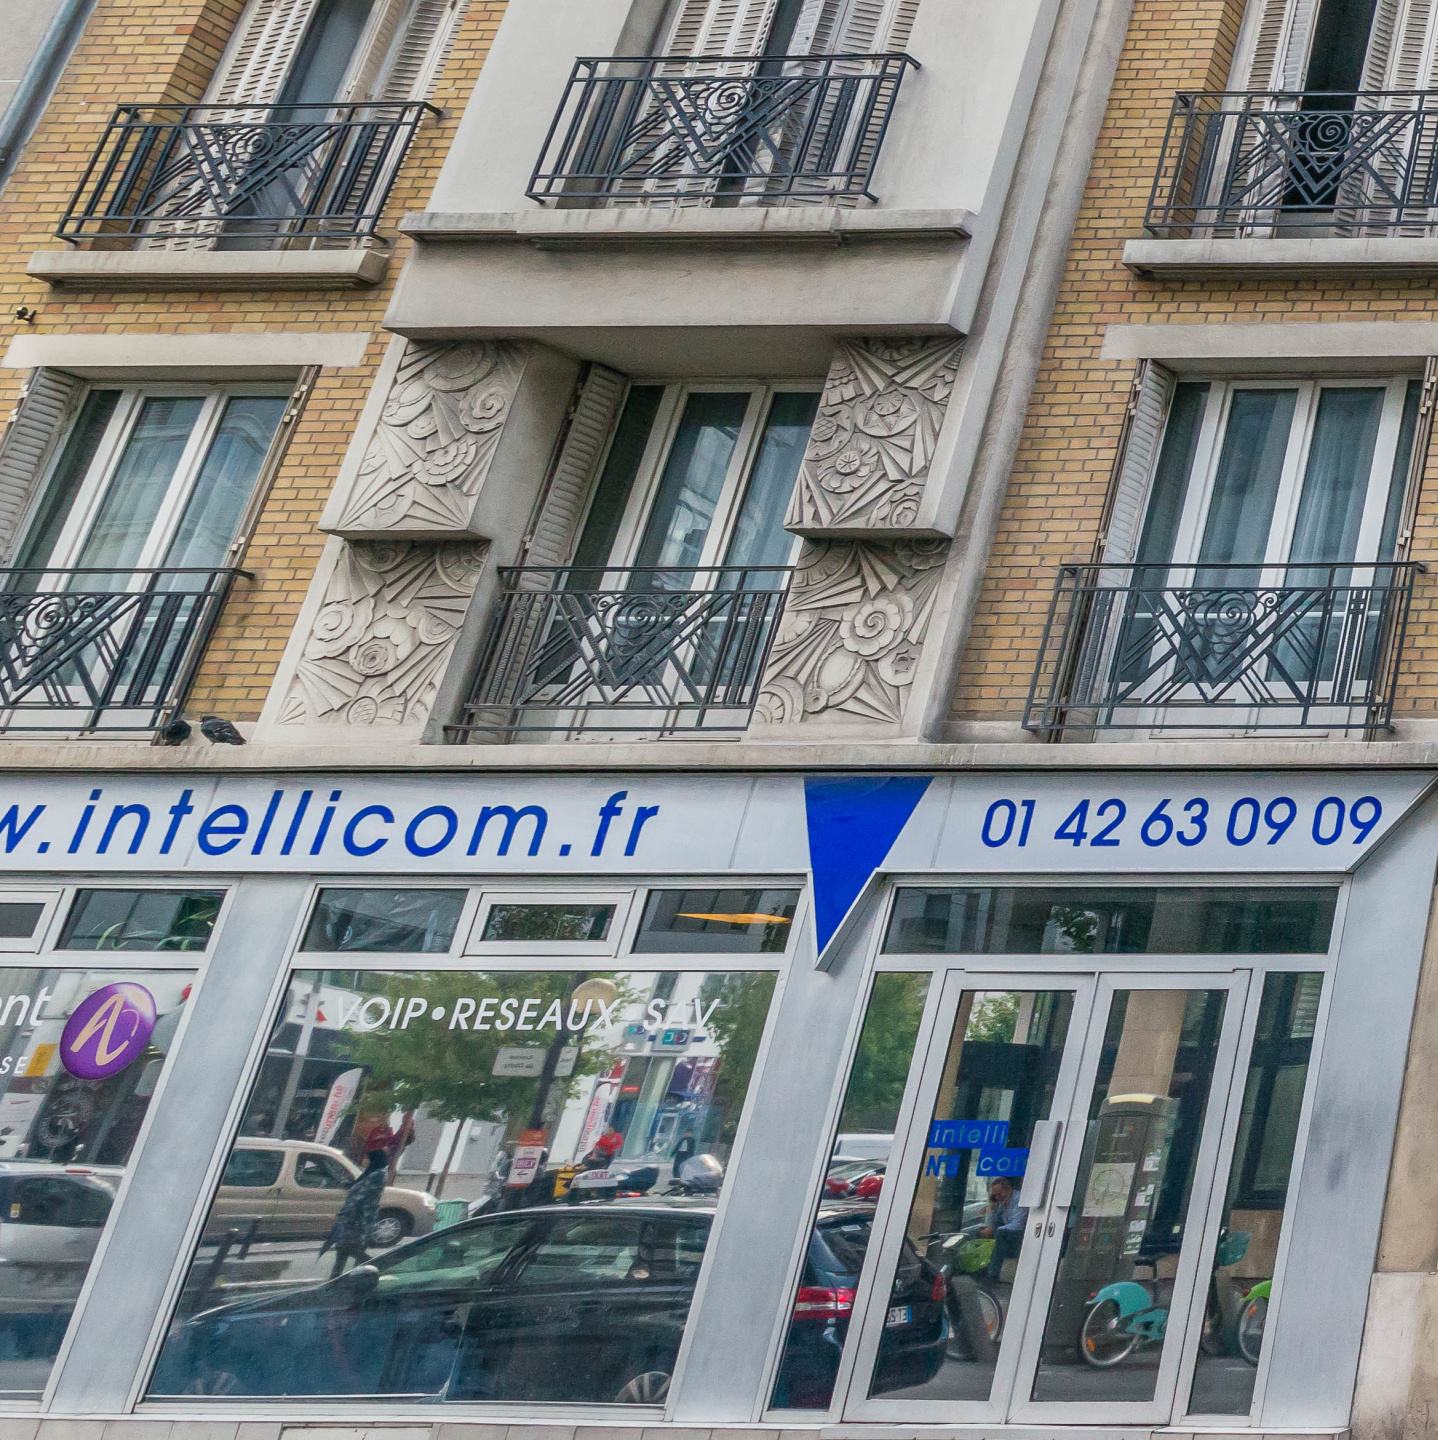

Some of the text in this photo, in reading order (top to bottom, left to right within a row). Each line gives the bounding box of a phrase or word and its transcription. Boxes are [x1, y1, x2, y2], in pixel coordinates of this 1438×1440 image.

[981, 795, 1383, 848] 01 42 63 09 09
[448, 997, 621, 1032] RESEAUX
[933, 1124, 1007, 1144] intelli
